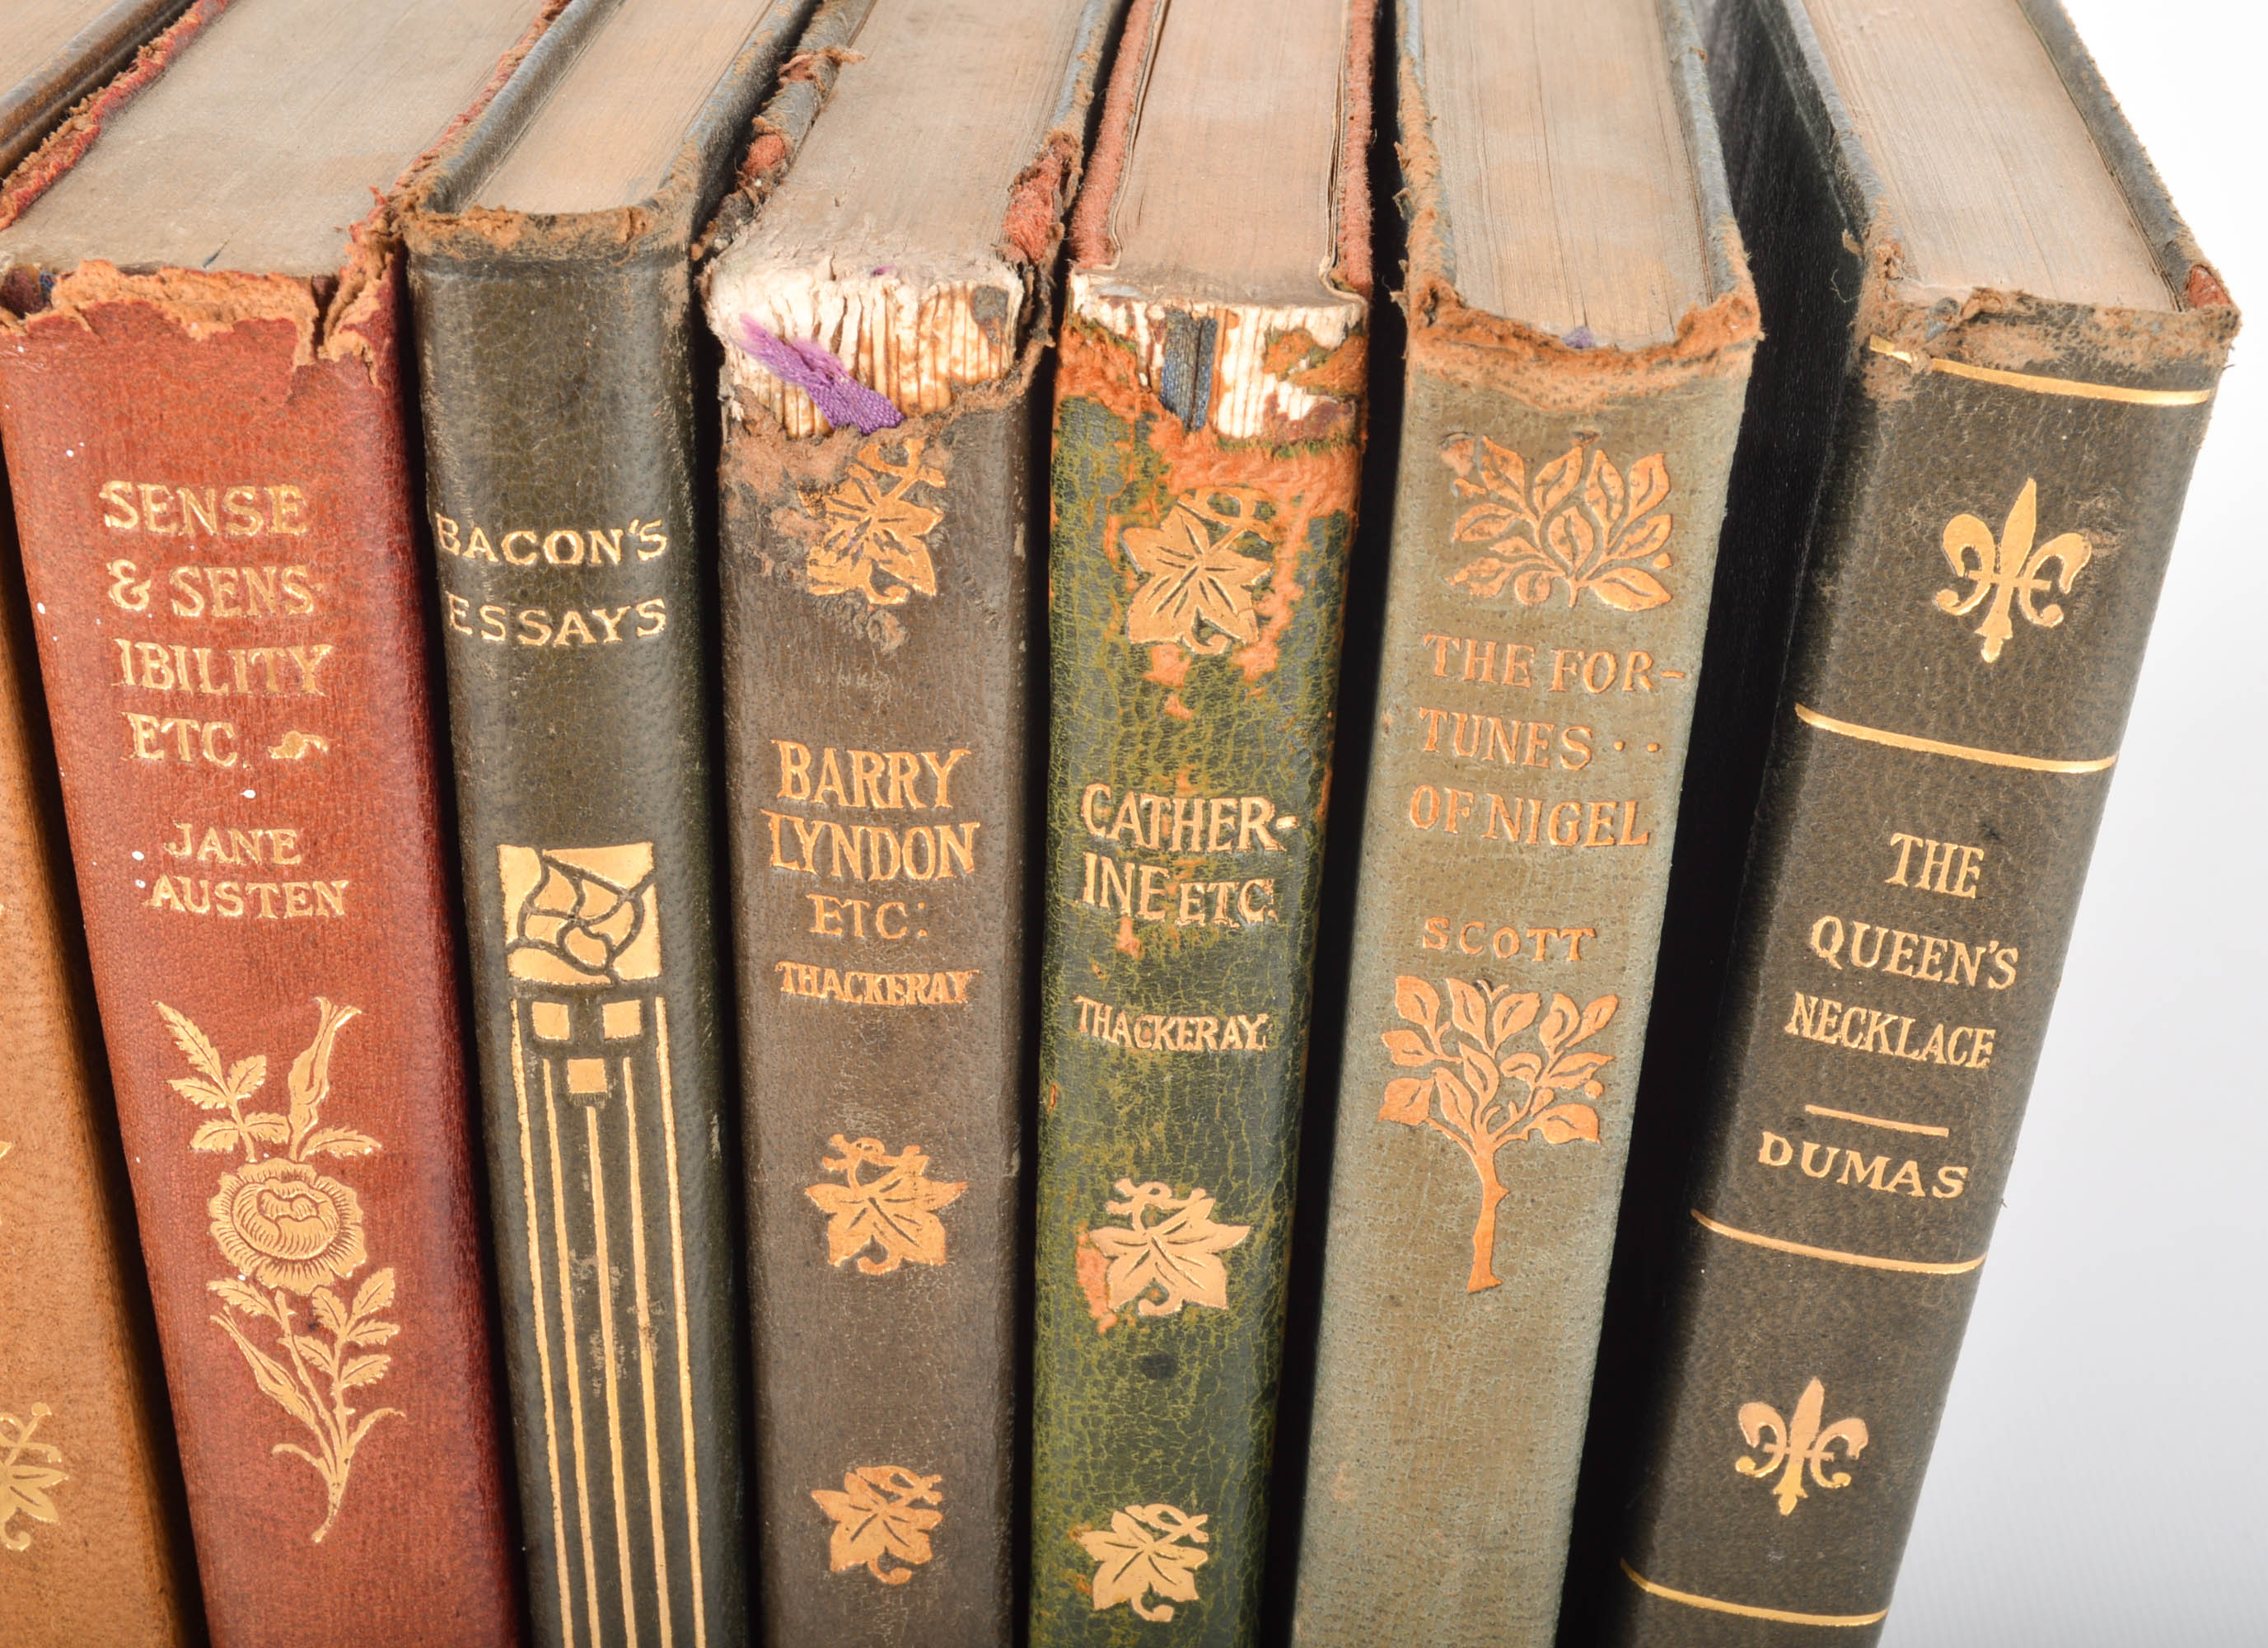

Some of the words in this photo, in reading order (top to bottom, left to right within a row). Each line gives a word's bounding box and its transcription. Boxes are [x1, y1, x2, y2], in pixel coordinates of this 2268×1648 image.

[99, 480, 307, 536] SENSE
[435, 513, 667, 565] BACON'S
[107, 559, 151, 611] &
[446, 591, 666, 647] ESSAYS
[110, 639, 332, 696] IBILITY
[1424, 634, 1535, 687] THE
[1548, 649, 1686, 694] FOR-
[771, 739, 971, 809] BARRY
[163, 821, 301, 865] JANE
[1081, 783, 1299, 852] CATHER-
[1410, 784, 1474, 834] OF
[1480, 793, 1648, 847] NIGEL
[760, 809, 980, 881] LYNDON
[1885, 832, 1984, 899] THE
[145, 873, 349, 920] AUSTEN
[1076, 852, 1170, 922] INE
[1422, 917, 1596, 962] SCOTT
[1810, 915, 2018, 990] QUEEN'S
[774, 960, 980, 1006] THACKERAY
[1074, 995, 1270, 1051] THACKERAY
[1784, 991, 1996, 1069] NECKLACE
[1757, 1131, 1969, 1199] DUMAS
